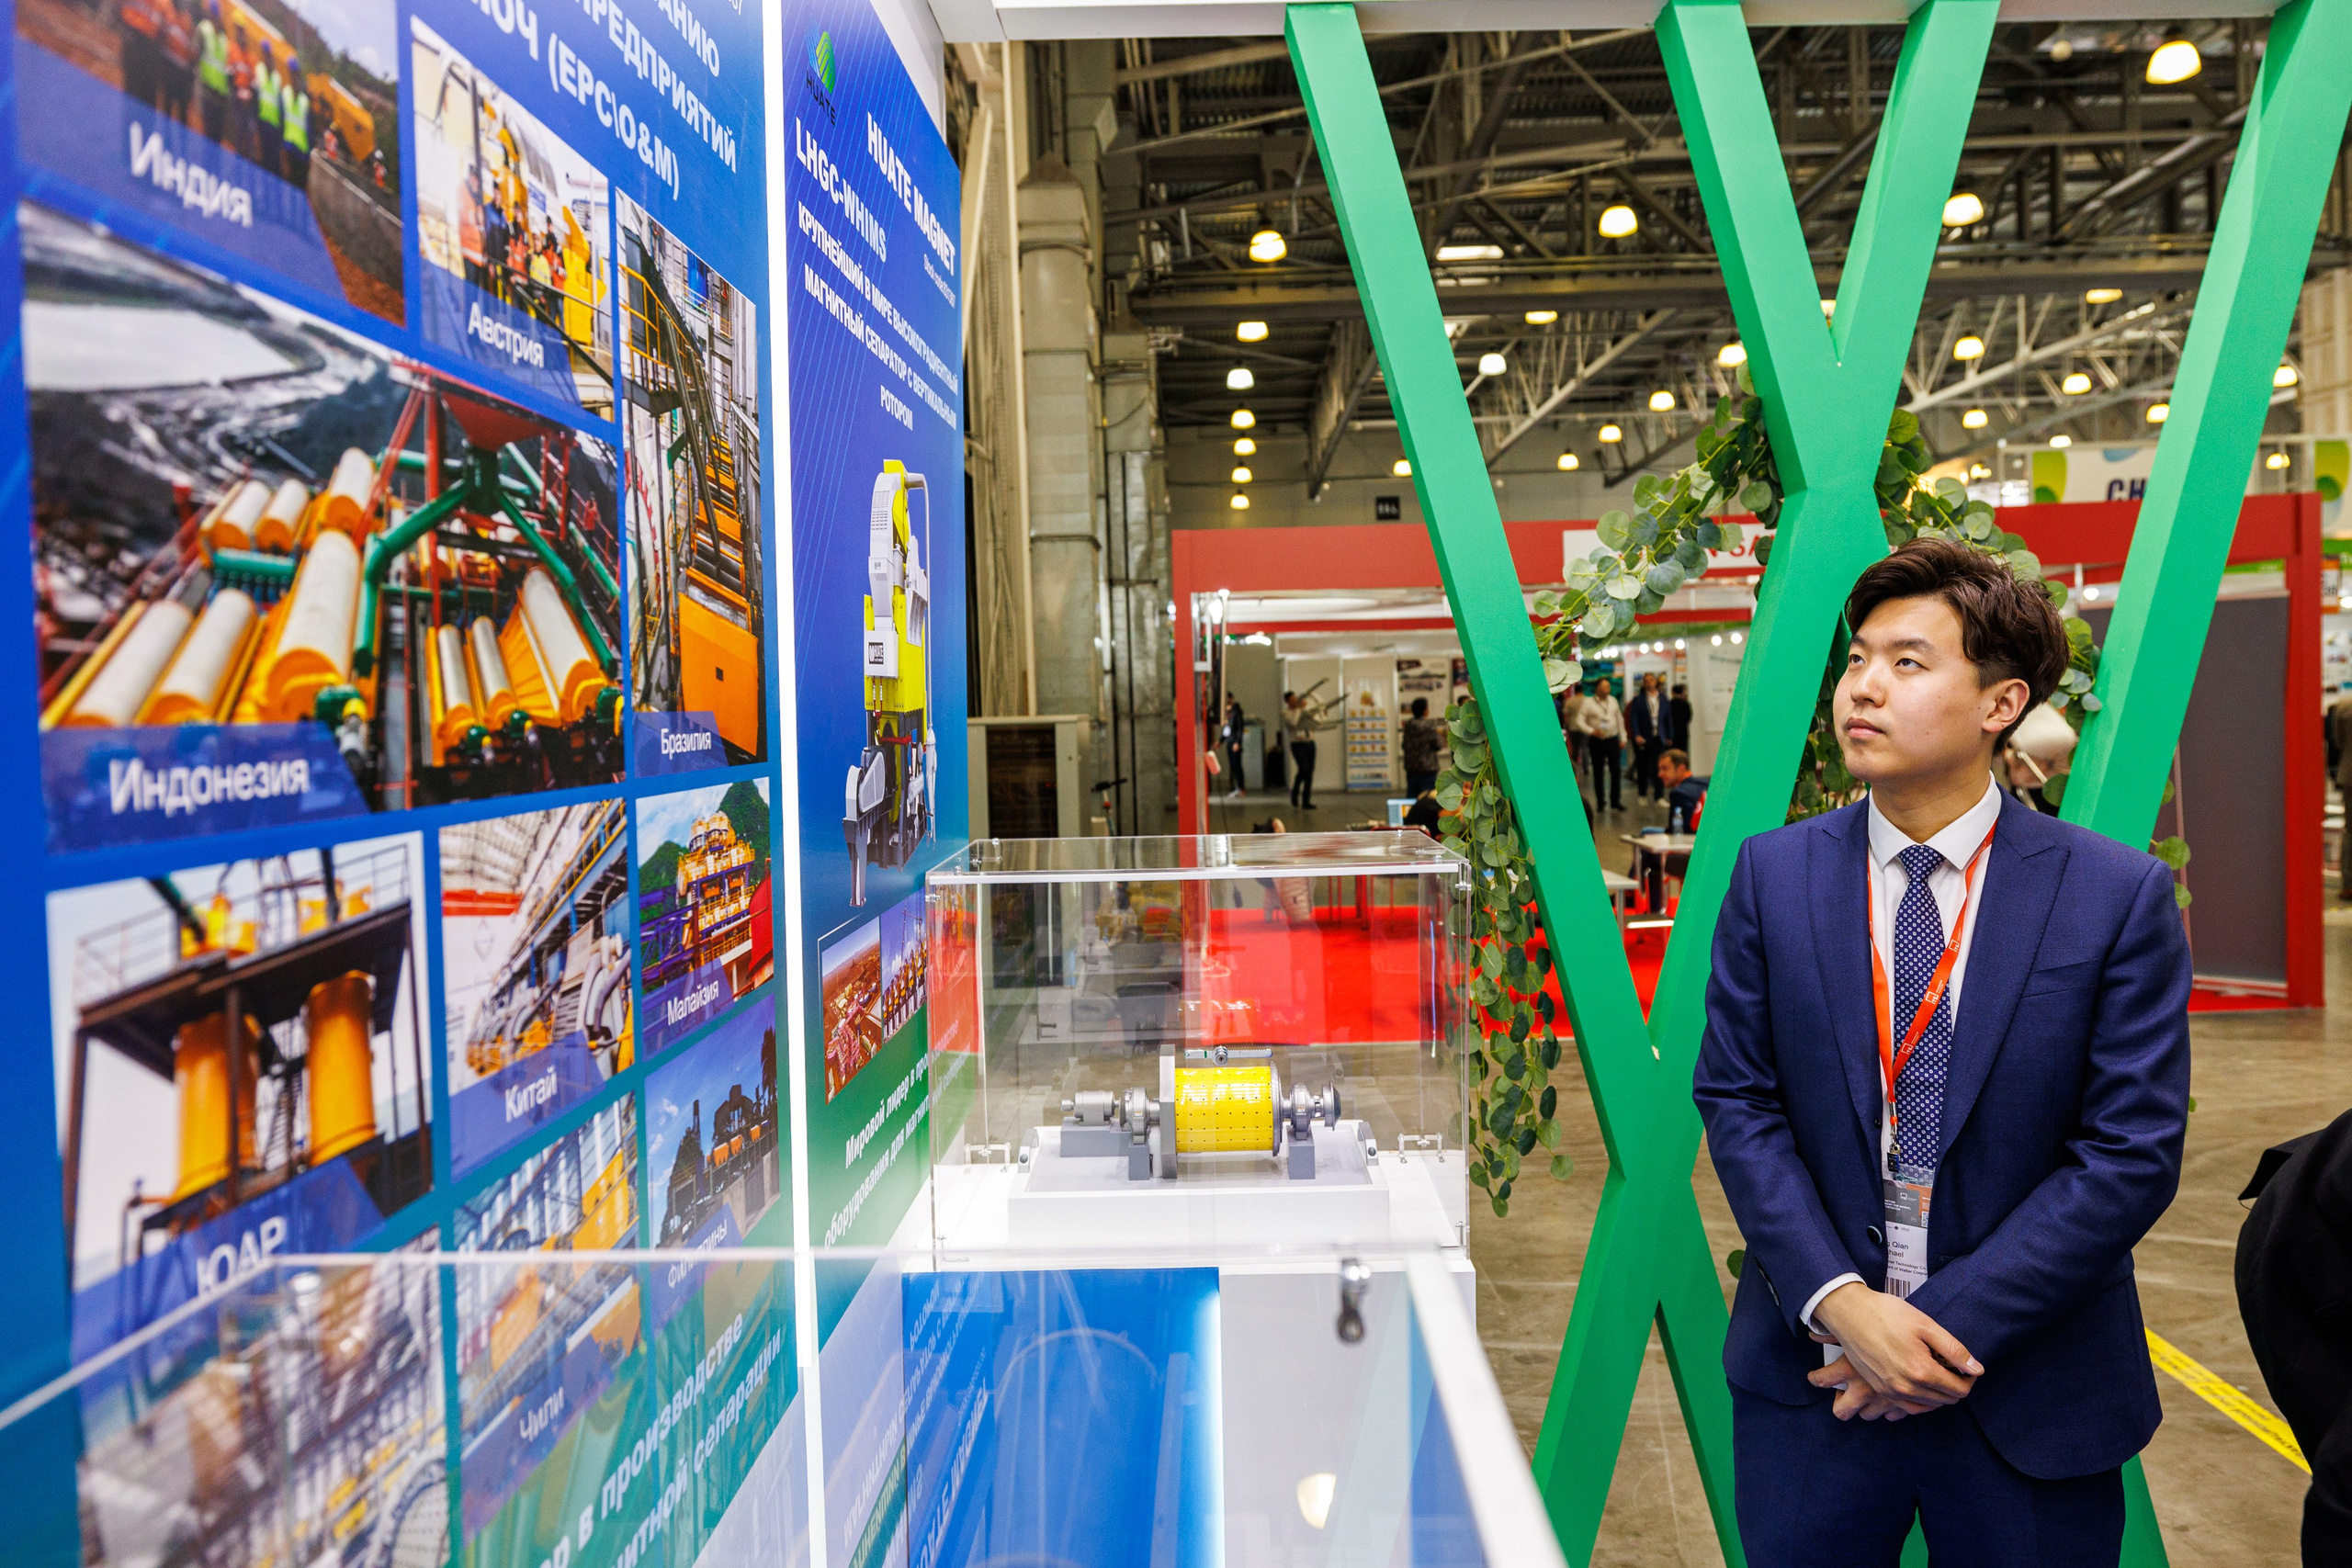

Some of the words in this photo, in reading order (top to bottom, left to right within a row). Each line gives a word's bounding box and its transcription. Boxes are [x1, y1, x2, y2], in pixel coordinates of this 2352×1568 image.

[654, 0, 720, 78] АНИЮ
[806, 70, 836, 127] HUATE
[130, 120, 253, 228] Индия
[796, 116, 888, 264] LHGC-WHIMS
[867, 111, 912, 213] HUATE
[913, 185, 956, 276] MAGNET
[468, 301, 545, 368] Австрия
[797, 199, 865, 296] КРУПНЕЙШИЙ
[865, 275, 871, 302] В
[871, 282, 893, 325] МИРЕ
[893, 307, 958, 397] ВЫСОКОГРАДИЕНТНЫЙ
[804, 263, 865, 344] МАГНИТНЫЙ
[865, 324, 907, 382] СЕПАРАТОР
[907, 367, 913, 389] С
[913, 371, 957, 431] ВЕРТИКАЛЬНЫМ
[880, 384, 913, 432] РОТОРОМ
[661, 728, 711, 761] Бразилия
[108, 757, 311, 818] Индонезия
[667, 979, 719, 1026] Малайзия
[504, 1064, 558, 1123] Китай
[845, 1098, 886, 1169] Мировой
[886, 1073, 910, 1119] лидер
[910, 1068, 916, 1088] в
[824, 1147, 889, 1250] оборудования
[889, 1127, 905, 1168] для
[196, 1214, 288, 1298] ЮАР
[1887, 1248, 1905, 1258] hael
[1892, 1240, 1909, 1250] Qian
[519, 1385, 564, 1443] Чили
[577, 1503, 594, 1551] в
[601, 1313, 742, 1520] производстве
[610, 1453, 688, 1568] итной
[692, 1328, 781, 1475] сепарации
